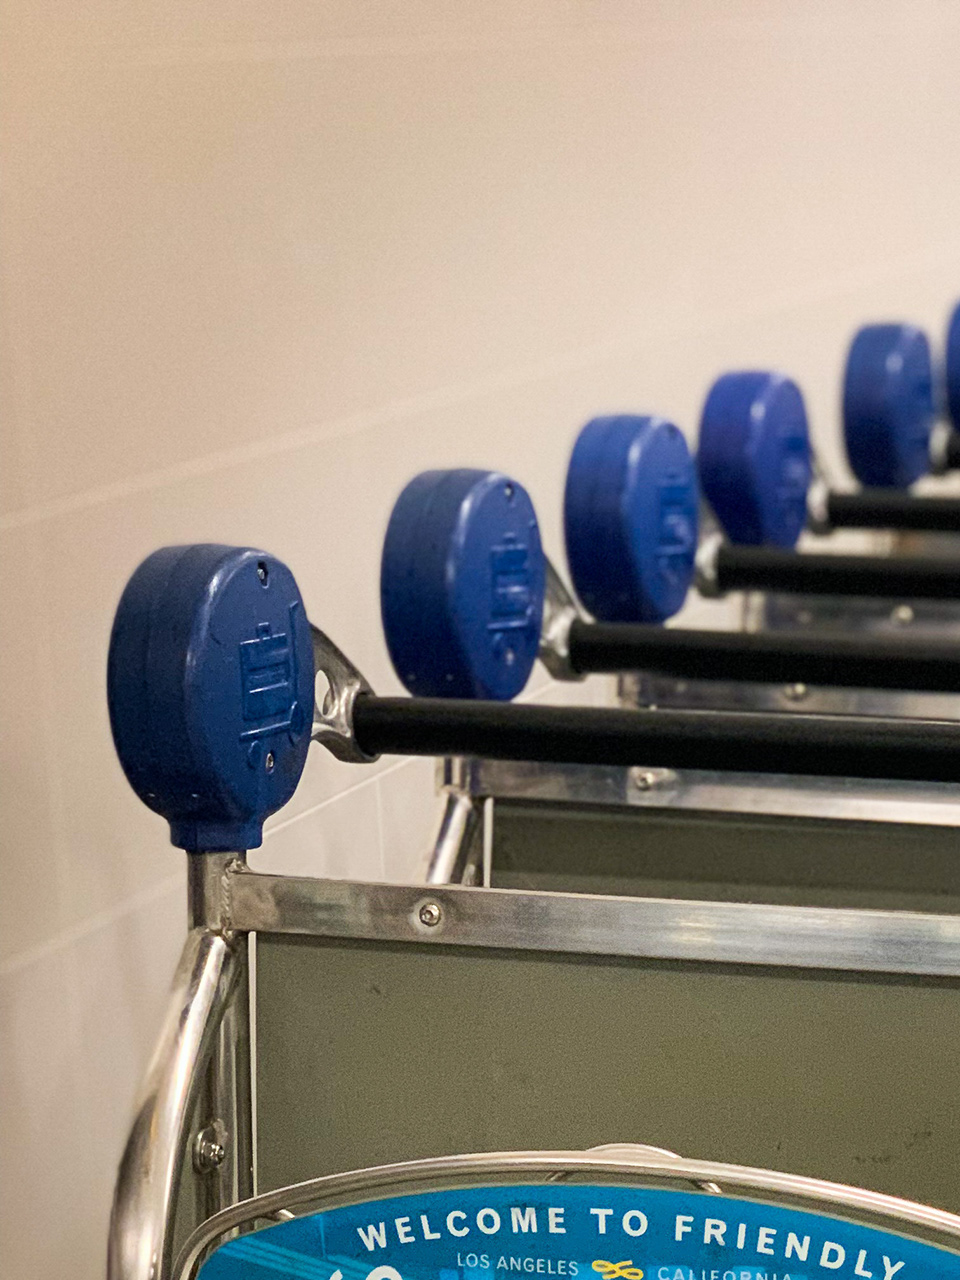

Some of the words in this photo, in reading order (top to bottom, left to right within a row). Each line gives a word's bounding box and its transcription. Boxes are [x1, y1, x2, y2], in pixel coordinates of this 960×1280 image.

[357, 1207, 567, 1251] WELCOME
[589, 1208, 649, 1237] TO
[456, 1252, 490, 1269] LOS
[496, 1255, 580, 1277] ANGELES
